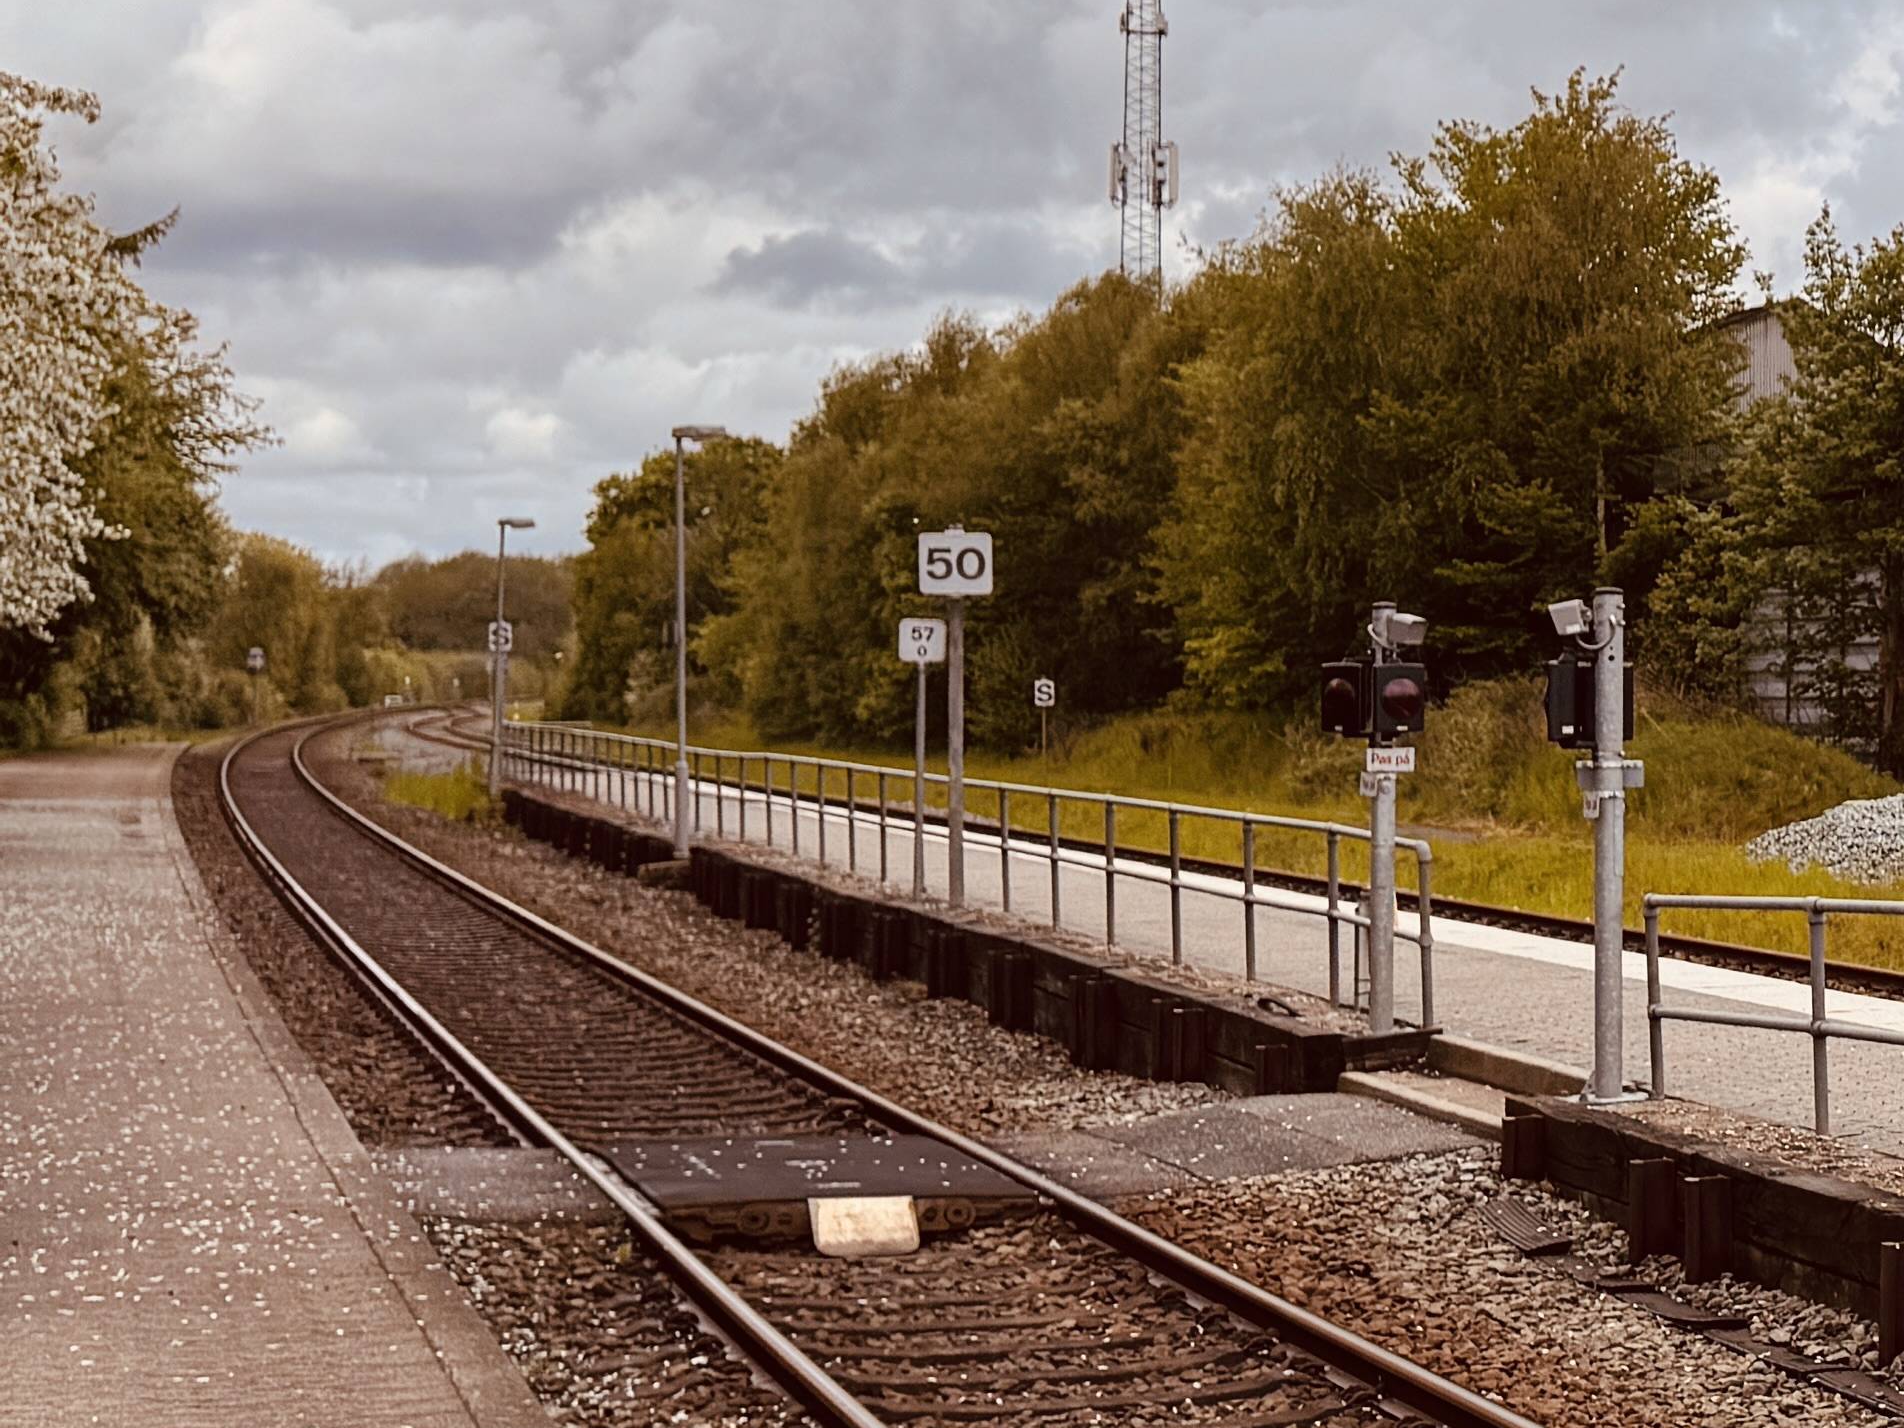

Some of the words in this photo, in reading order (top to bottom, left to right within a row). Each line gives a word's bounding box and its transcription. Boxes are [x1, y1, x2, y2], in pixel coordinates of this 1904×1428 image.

[925, 547, 986, 581] 50
[911, 626, 934, 642] 57
[917, 645, 928, 657] 0
[1037, 683, 1053, 702] S
